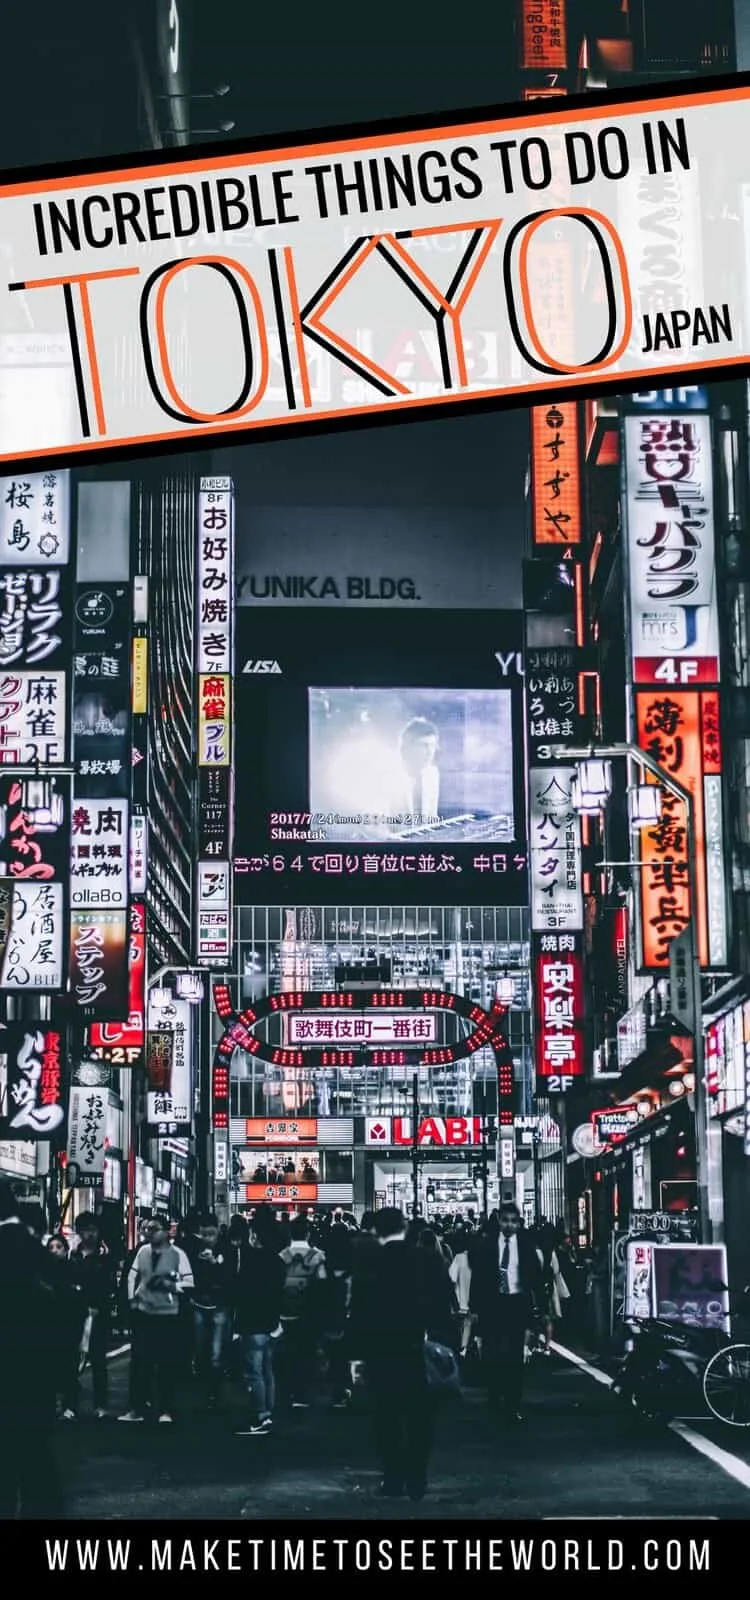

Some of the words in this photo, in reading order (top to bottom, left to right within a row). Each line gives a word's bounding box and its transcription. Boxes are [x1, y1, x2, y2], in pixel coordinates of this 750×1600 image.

[543, 431, 572, 541] すずや
[207, 493, 224, 503] 8F
[634, 419, 709, 599] 熟女キャバクラ
[5, 481, 35, 552] 桜島
[202, 506, 229, 657] お好み焼き
[237, 576, 339, 600] YUNIKA
[346, 576, 422, 600] BLDG.
[207, 662, 223, 672] 7F
[242, 659, 283, 674] LISA
[655, 658, 699, 684] 4F
[26, 676, 58, 738] 麻雀
[206, 811, 222, 820] 117
[271, 828, 327, 840] Shakatak
[205, 841, 224, 855] 4F
[536, 812, 561, 897] バンタイ
[72, 889, 123, 903] ollaBo
[31, 886, 57, 964] 居酒屋
[547, 916, 567, 927] 3F
[541, 934, 576, 952] 焼肉
[75, 926, 108, 1005] ステップ
[542, 961, 576, 1067] 安楽亭
[294, 1018, 433, 1039] 歌舞伎町一番街
[547, 1076, 574, 1092] 2F
[158, 1123, 178, 1134] 2F
[393, 1116, 481, 1145] LABI
